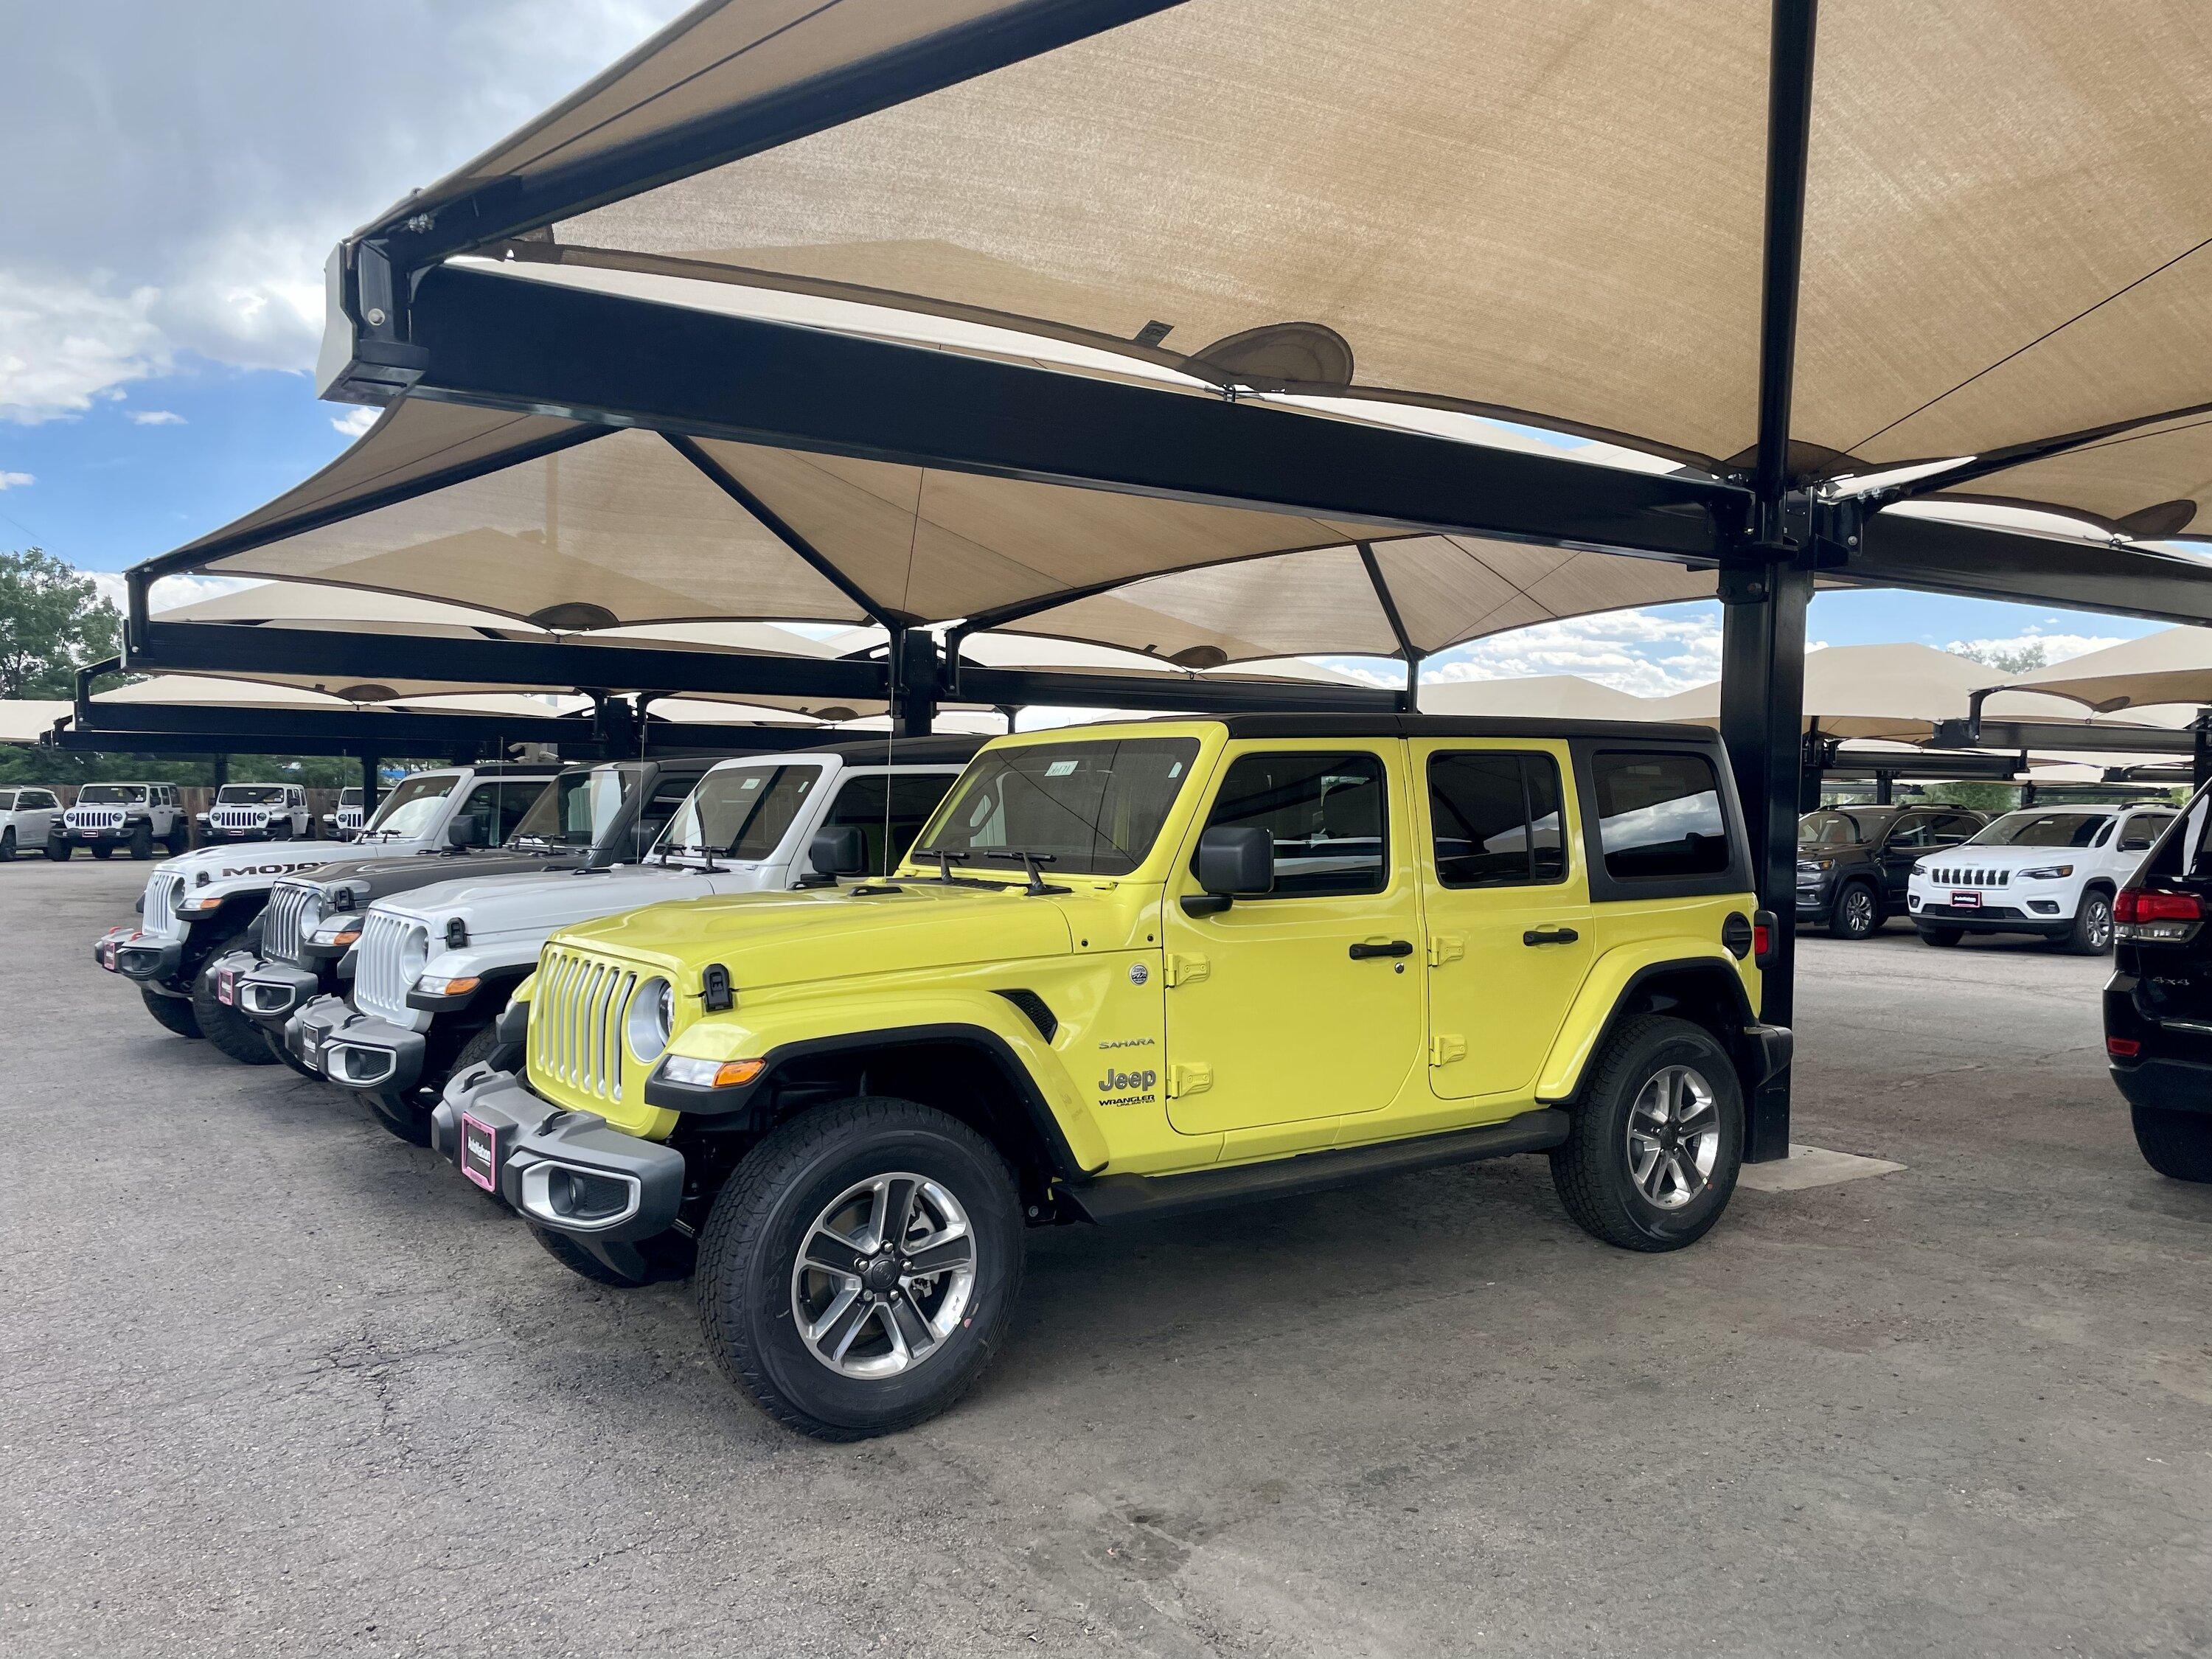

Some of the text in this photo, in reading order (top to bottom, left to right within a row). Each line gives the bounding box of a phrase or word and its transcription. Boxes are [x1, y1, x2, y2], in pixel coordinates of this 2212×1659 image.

[1099, 1038, 1155, 1048] SAHARA
[1099, 1068, 1156, 1092] Jeep
[1099, 1094, 1155, 1106] WRANGLER
